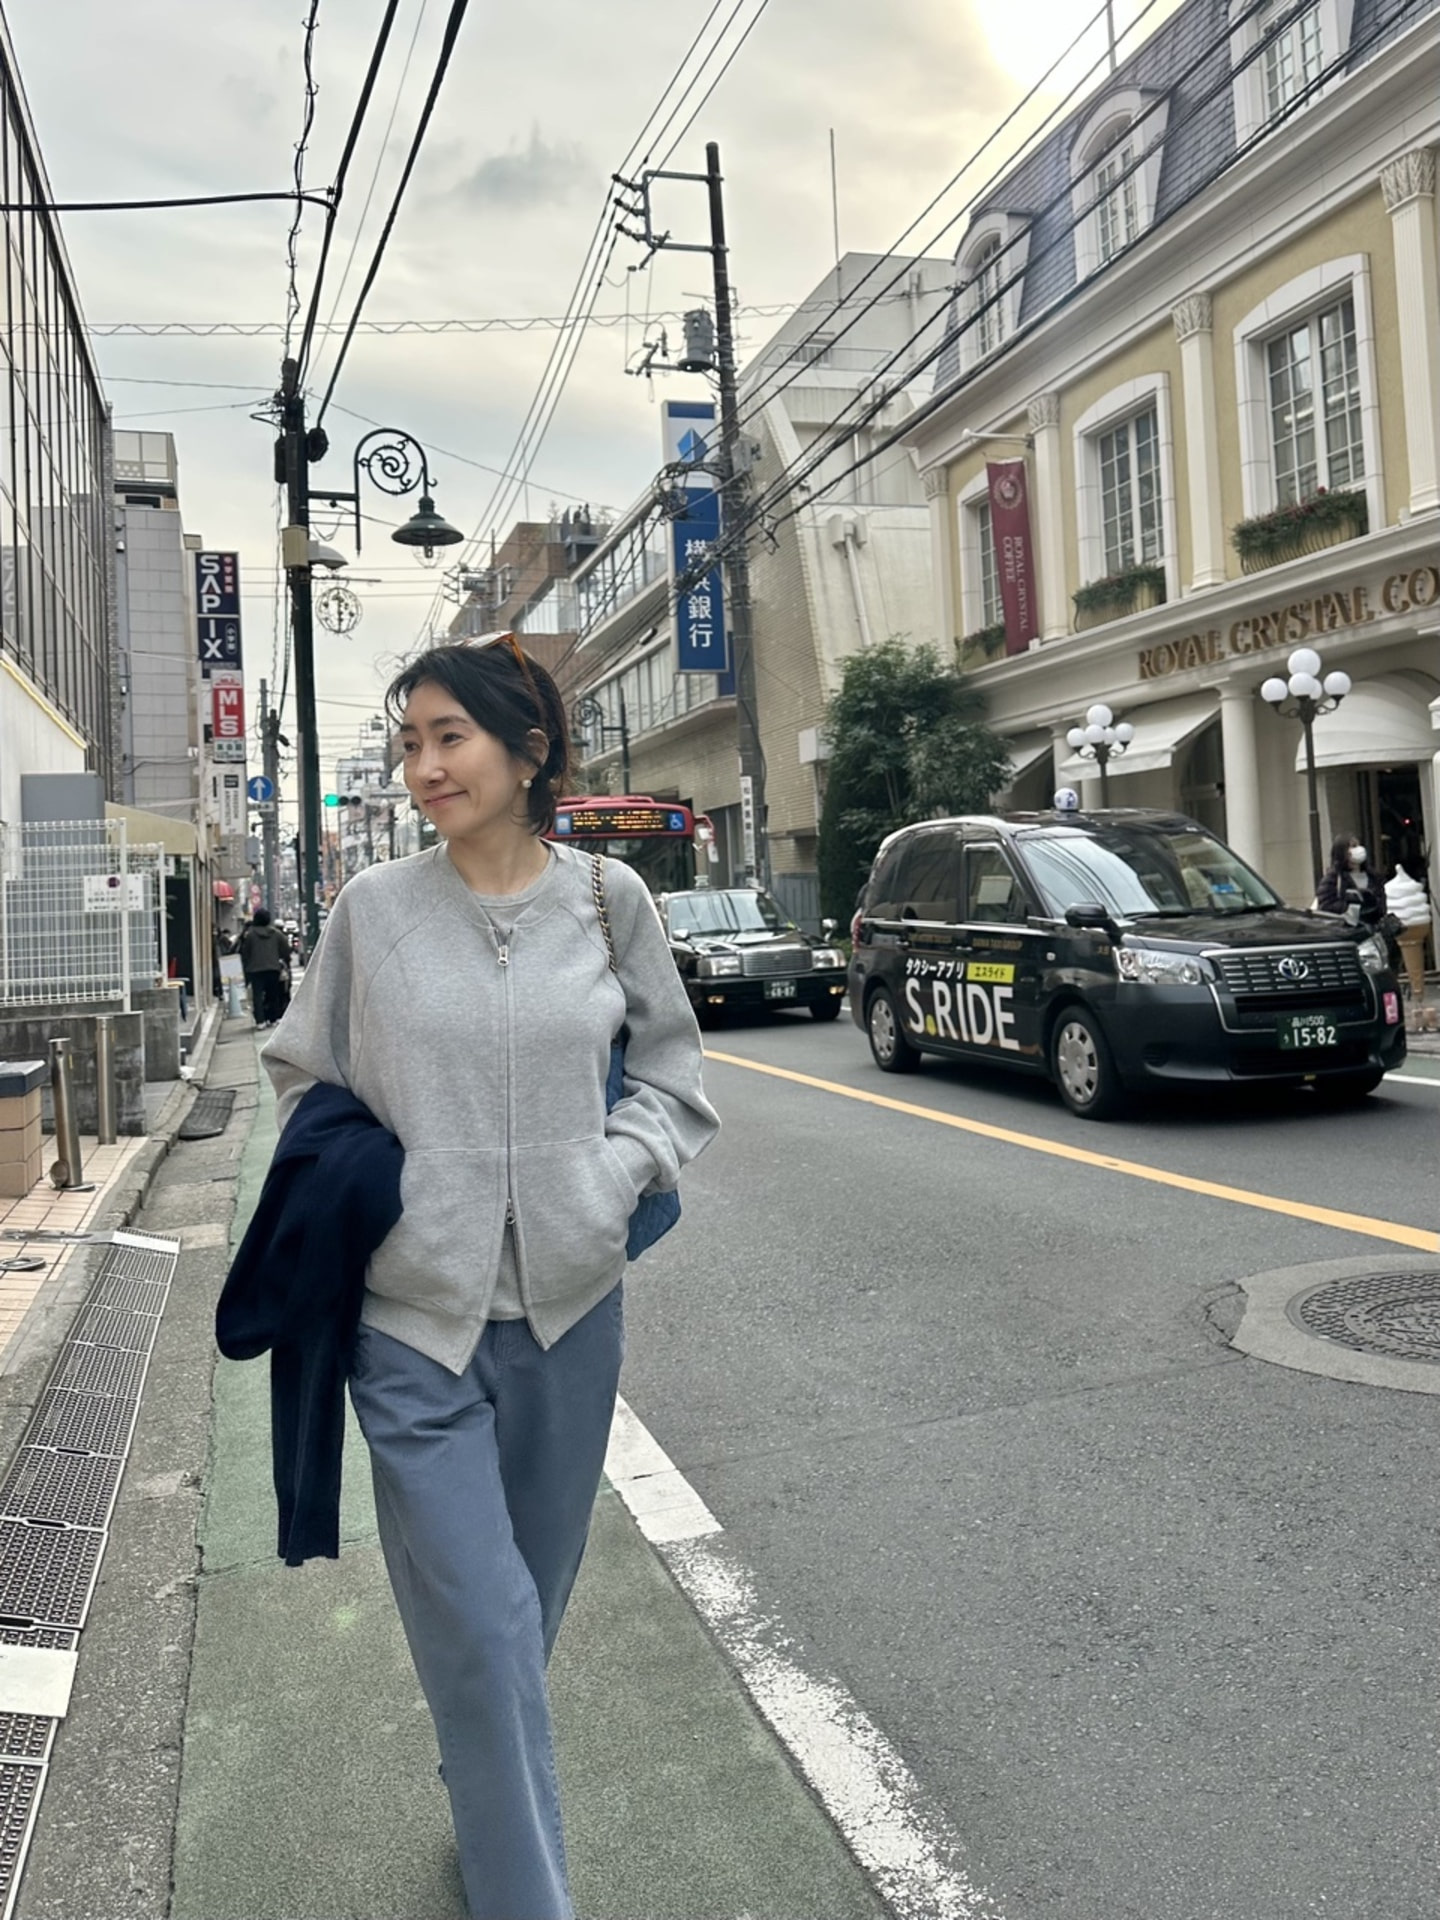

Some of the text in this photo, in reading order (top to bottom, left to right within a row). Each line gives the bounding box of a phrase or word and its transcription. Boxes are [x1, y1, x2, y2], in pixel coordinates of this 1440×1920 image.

[1003, 536, 1016, 583] COFFEE
[200, 554, 224, 659] SAPIX
[1013, 536, 1029, 632] ROYAL CRYSTAL
[1138, 565, 1440, 680] ROYAL CRYSTAL CO
[218, 689, 239, 736] MLS
[905, 958, 965, 979] タクシーアプリ
[974, 965, 1006, 979] エスライド
[905, 977, 1021, 1051] S.RIDE
[1293, 1026, 1337, 1047] 15-82
